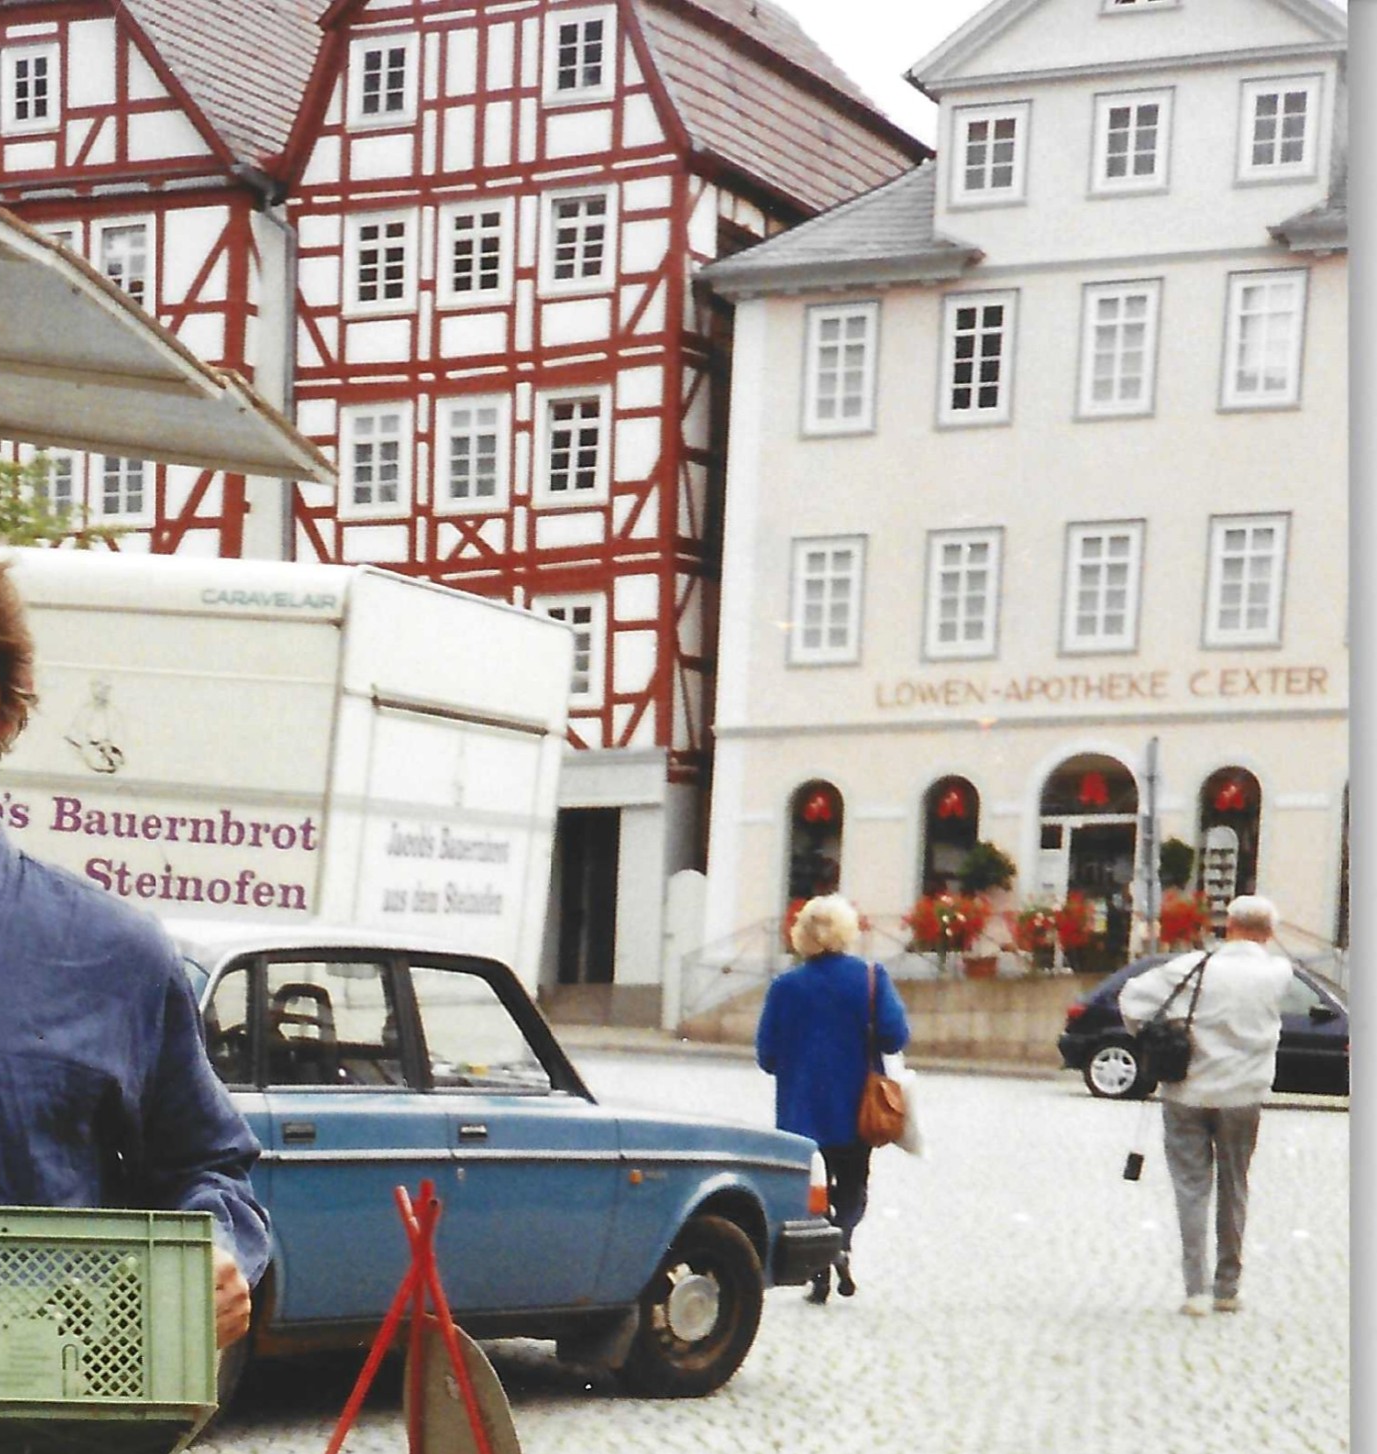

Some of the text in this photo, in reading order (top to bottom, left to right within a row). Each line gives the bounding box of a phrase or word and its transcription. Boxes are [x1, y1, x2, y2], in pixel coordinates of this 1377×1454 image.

[201, 588, 337, 608] CARAVELAIR
[49, 796, 318, 852] Bauernbrot
[85, 857, 307, 910] Steinofen
